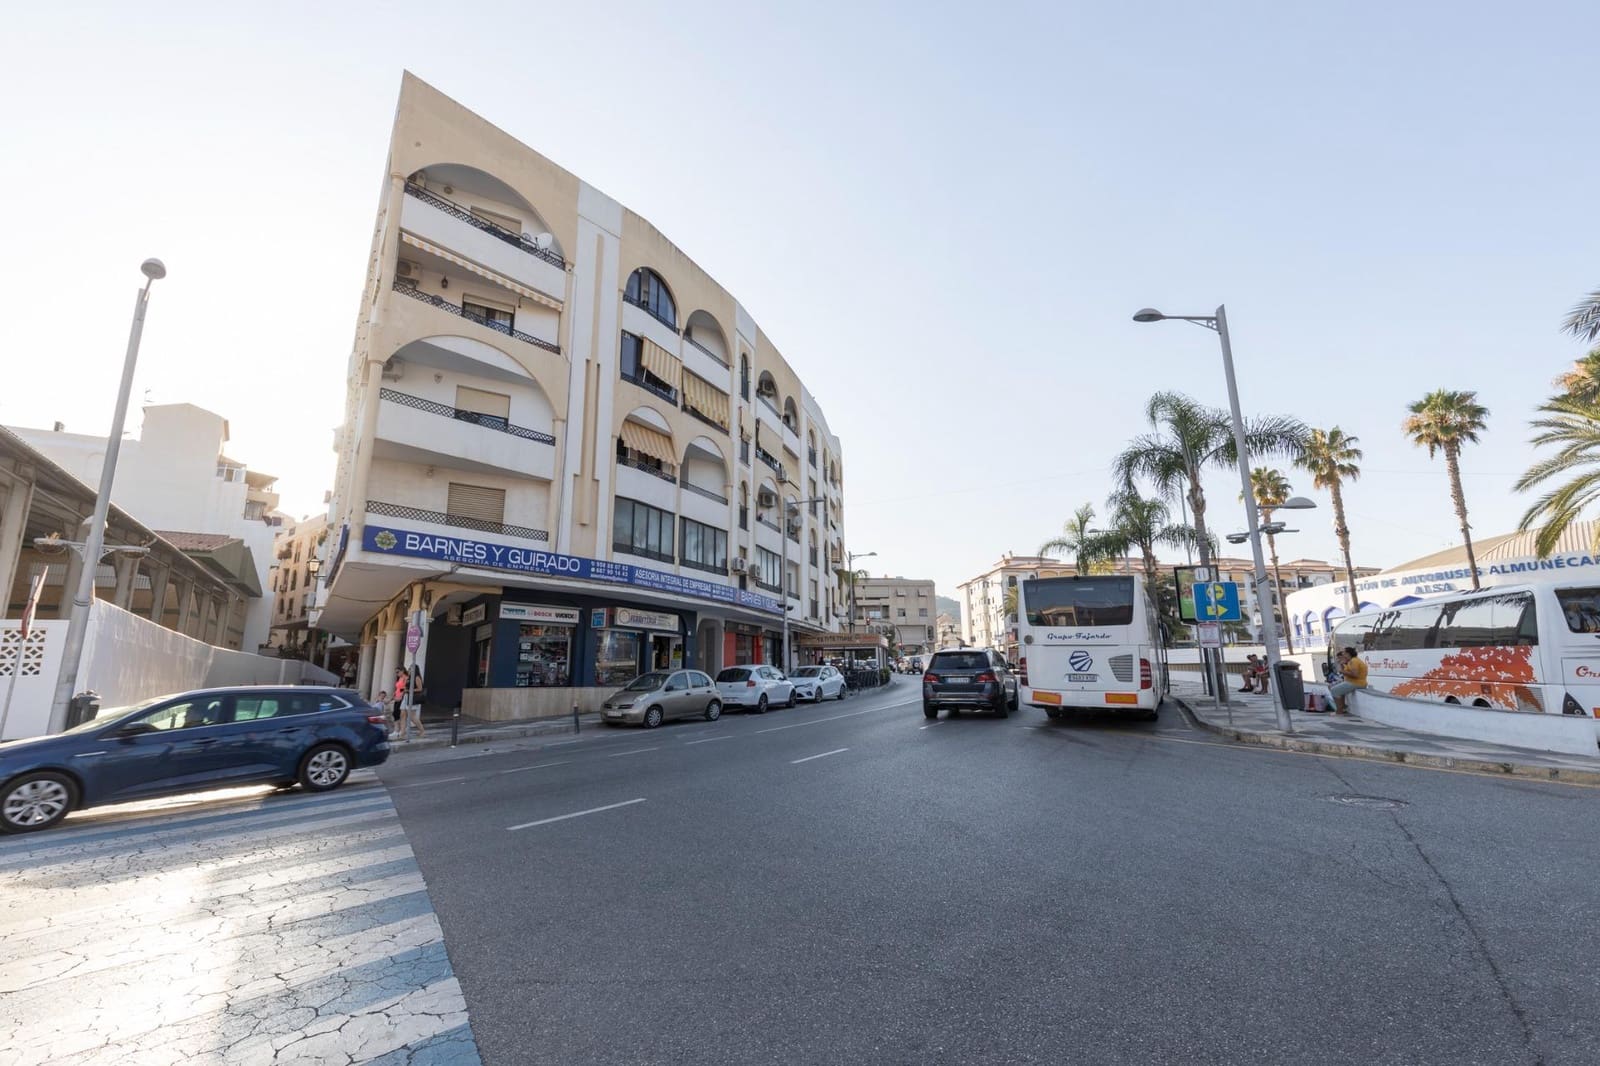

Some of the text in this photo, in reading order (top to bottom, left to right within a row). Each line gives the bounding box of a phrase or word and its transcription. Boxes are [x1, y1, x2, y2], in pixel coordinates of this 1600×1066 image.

[405, 534, 580, 572] BARNÉS Y GUIRADO
[507, 563, 551, 573] EMPRESAS
[1381, 578, 1397, 588] DE
[1401, 567, 1483, 585] AUTOBUSES
[1414, 582, 1455, 594] ALSA
[1047, 632, 1111, 641] Grupo Fajardo
